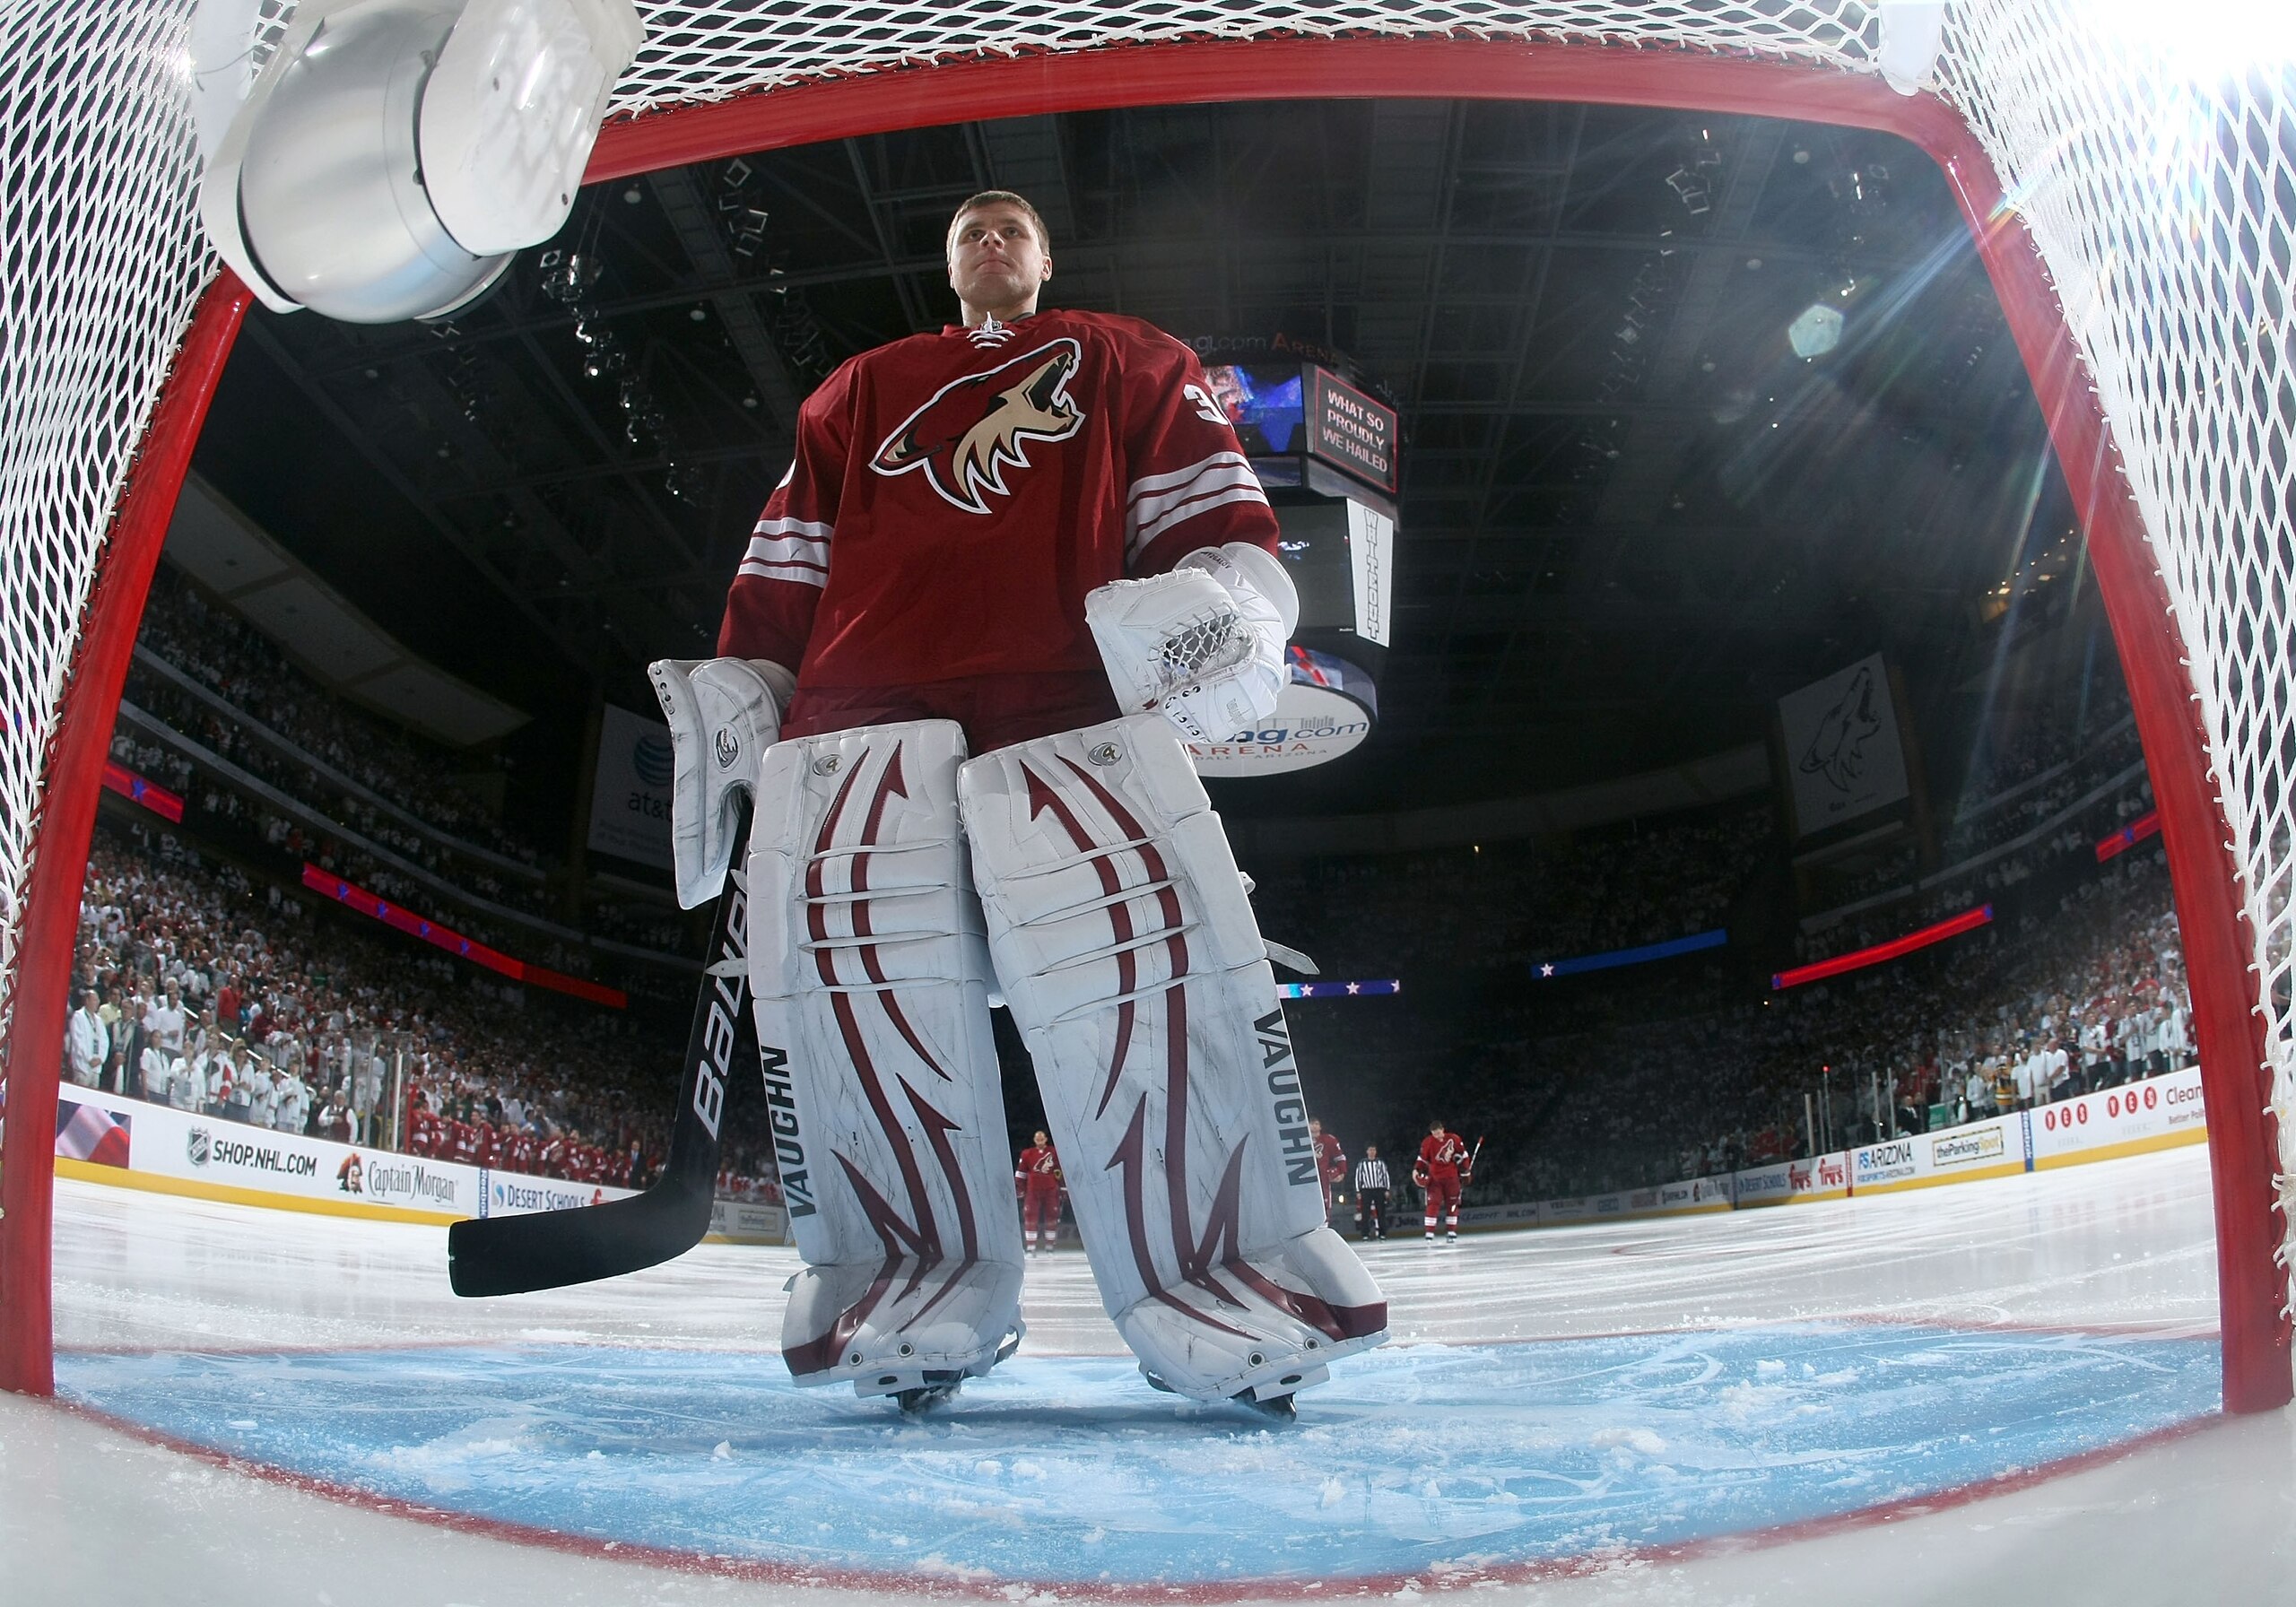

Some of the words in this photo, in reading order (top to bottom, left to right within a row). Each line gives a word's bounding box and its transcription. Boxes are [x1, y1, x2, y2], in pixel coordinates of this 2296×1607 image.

[1182, 383, 1234, 433] 3
[1327, 388, 1363, 421] WHAT
[1366, 412, 1384, 431] SO
[1327, 409, 1384, 450] PROUDLY
[1323, 426, 1344, 449] WE
[1345, 439, 1387, 473] HAILED
[1253, 1007, 1318, 1186] VAUGHN
[761, 1045, 818, 1219] VAUGHN
[213, 1139, 317, 1177] SHOP.NHL.COM
[1870, 1142, 1913, 1168] ARIZONA
[369, 1161, 411, 1198] Captain
[411, 1165, 456, 1204] Morgan
[508, 1185, 543, 1210] DESERT
